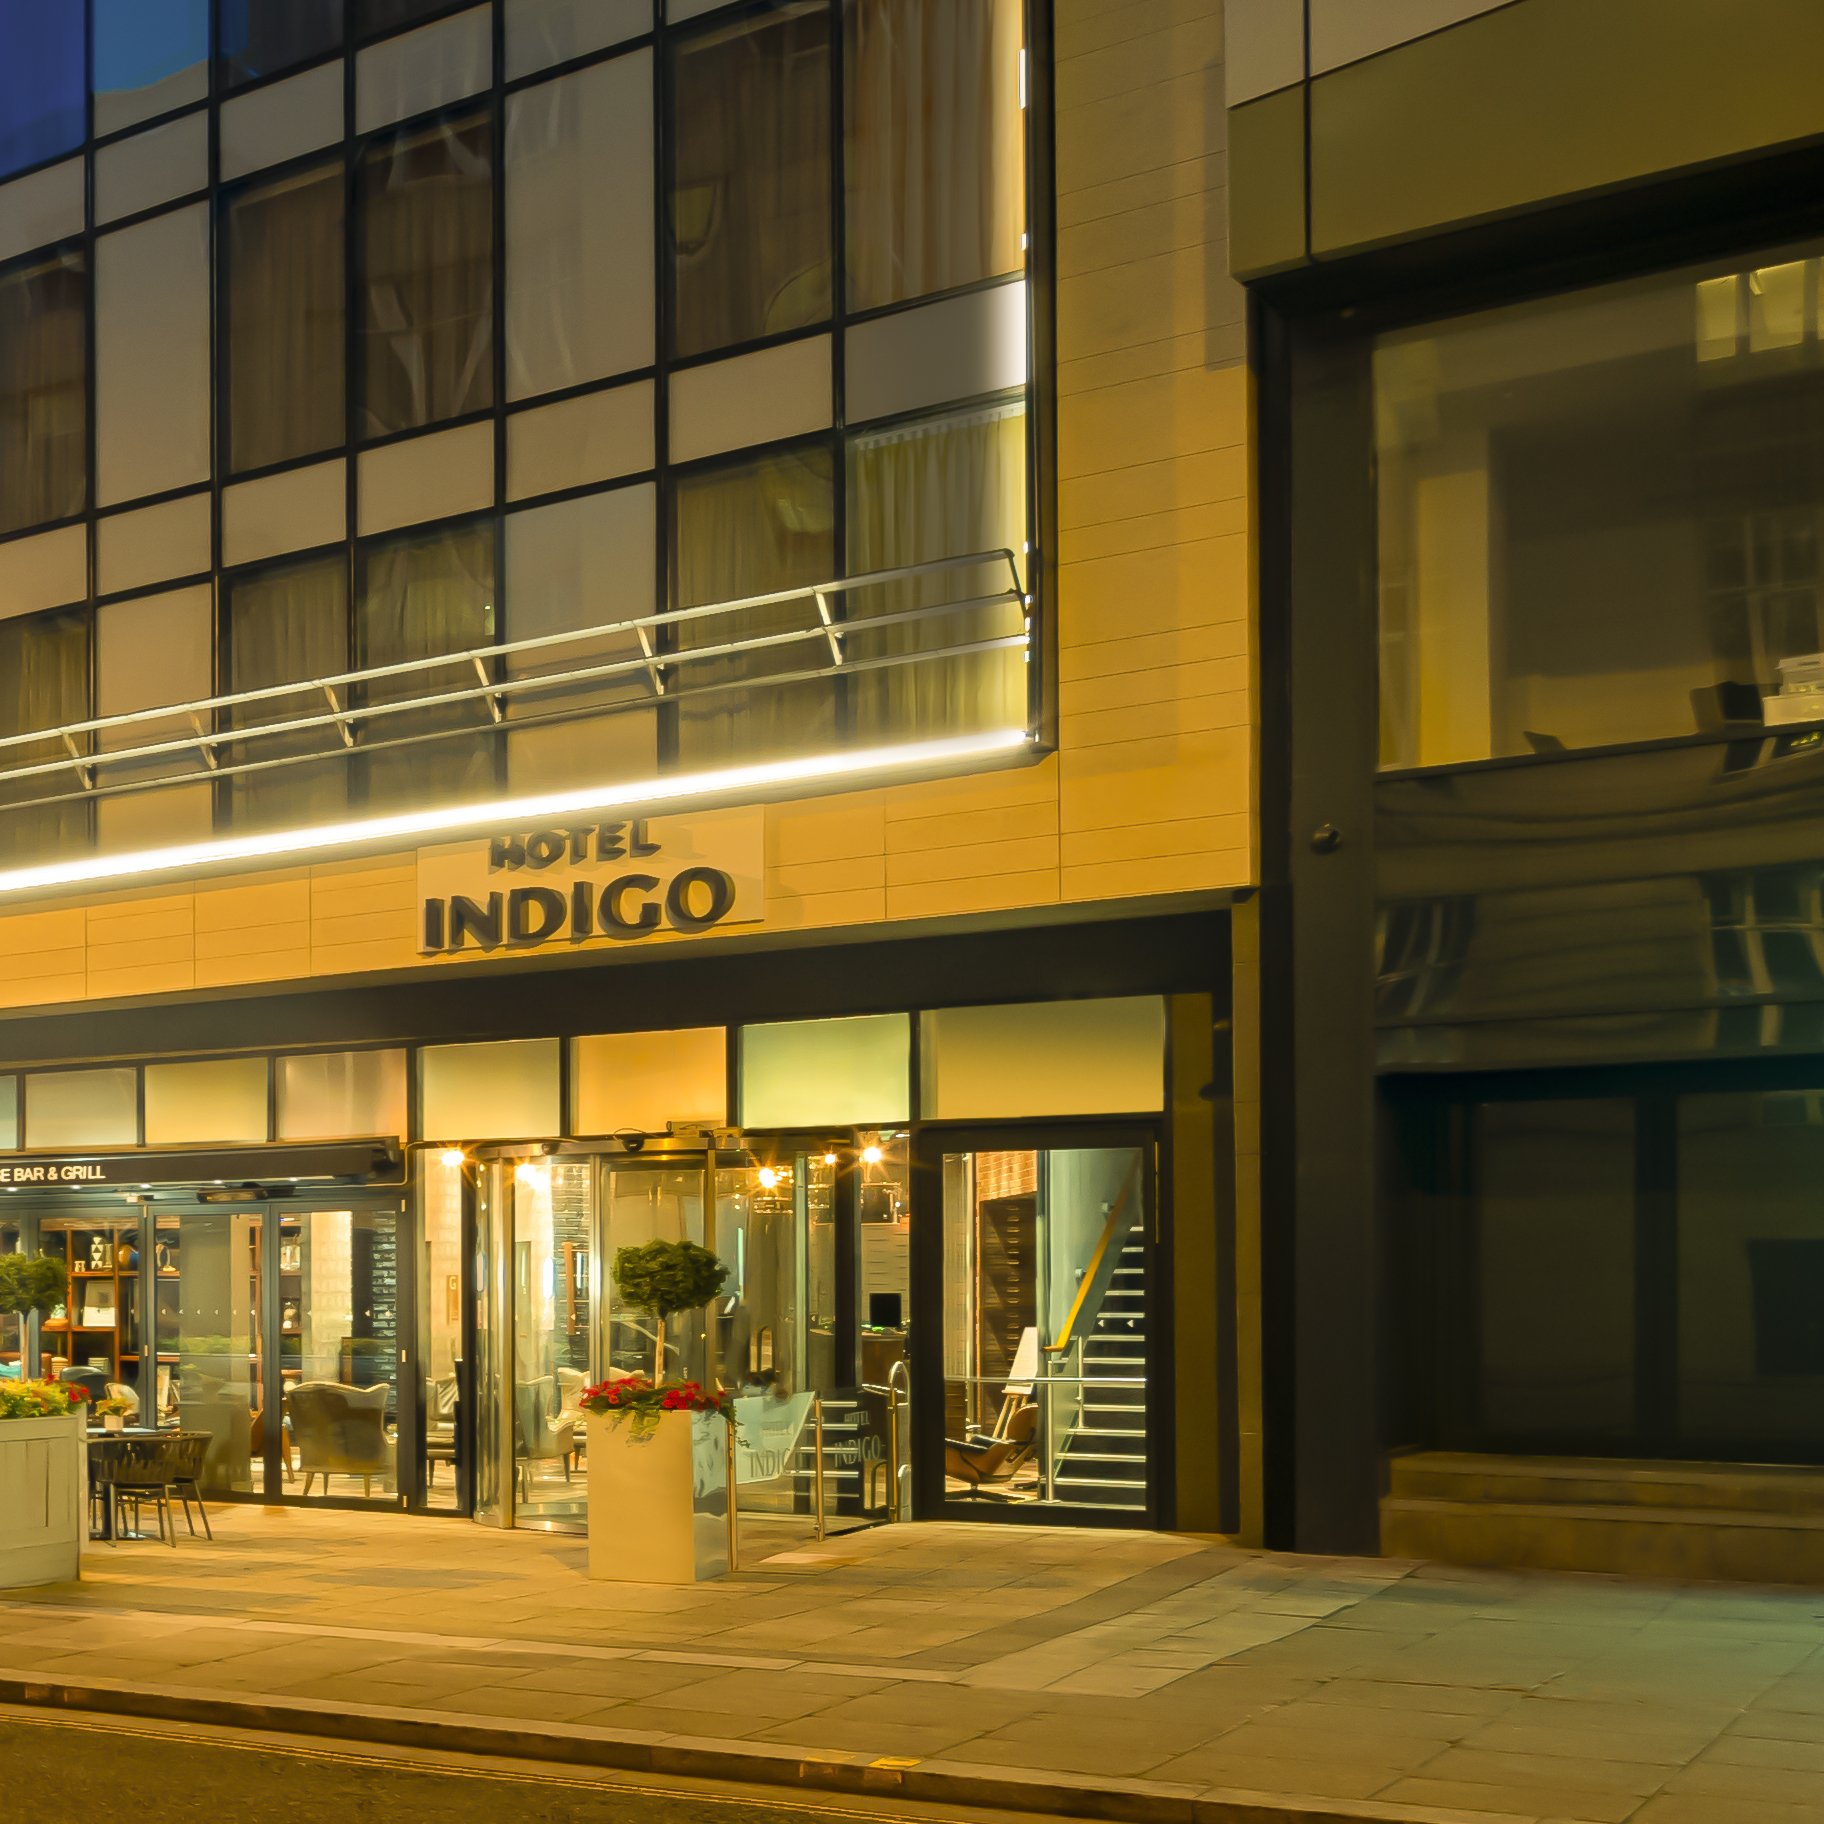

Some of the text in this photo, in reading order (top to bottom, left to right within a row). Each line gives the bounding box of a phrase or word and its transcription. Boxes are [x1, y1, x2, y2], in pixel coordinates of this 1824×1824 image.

[490, 819, 662, 870] HOTEL
[424, 866, 737, 949] INDIGO
[12, 1166, 44, 1183] BAR
[46, 1167, 58, 1181] &
[60, 1165, 107, 1181] GRILL
[834, 1434, 881, 1468] INDIGO
